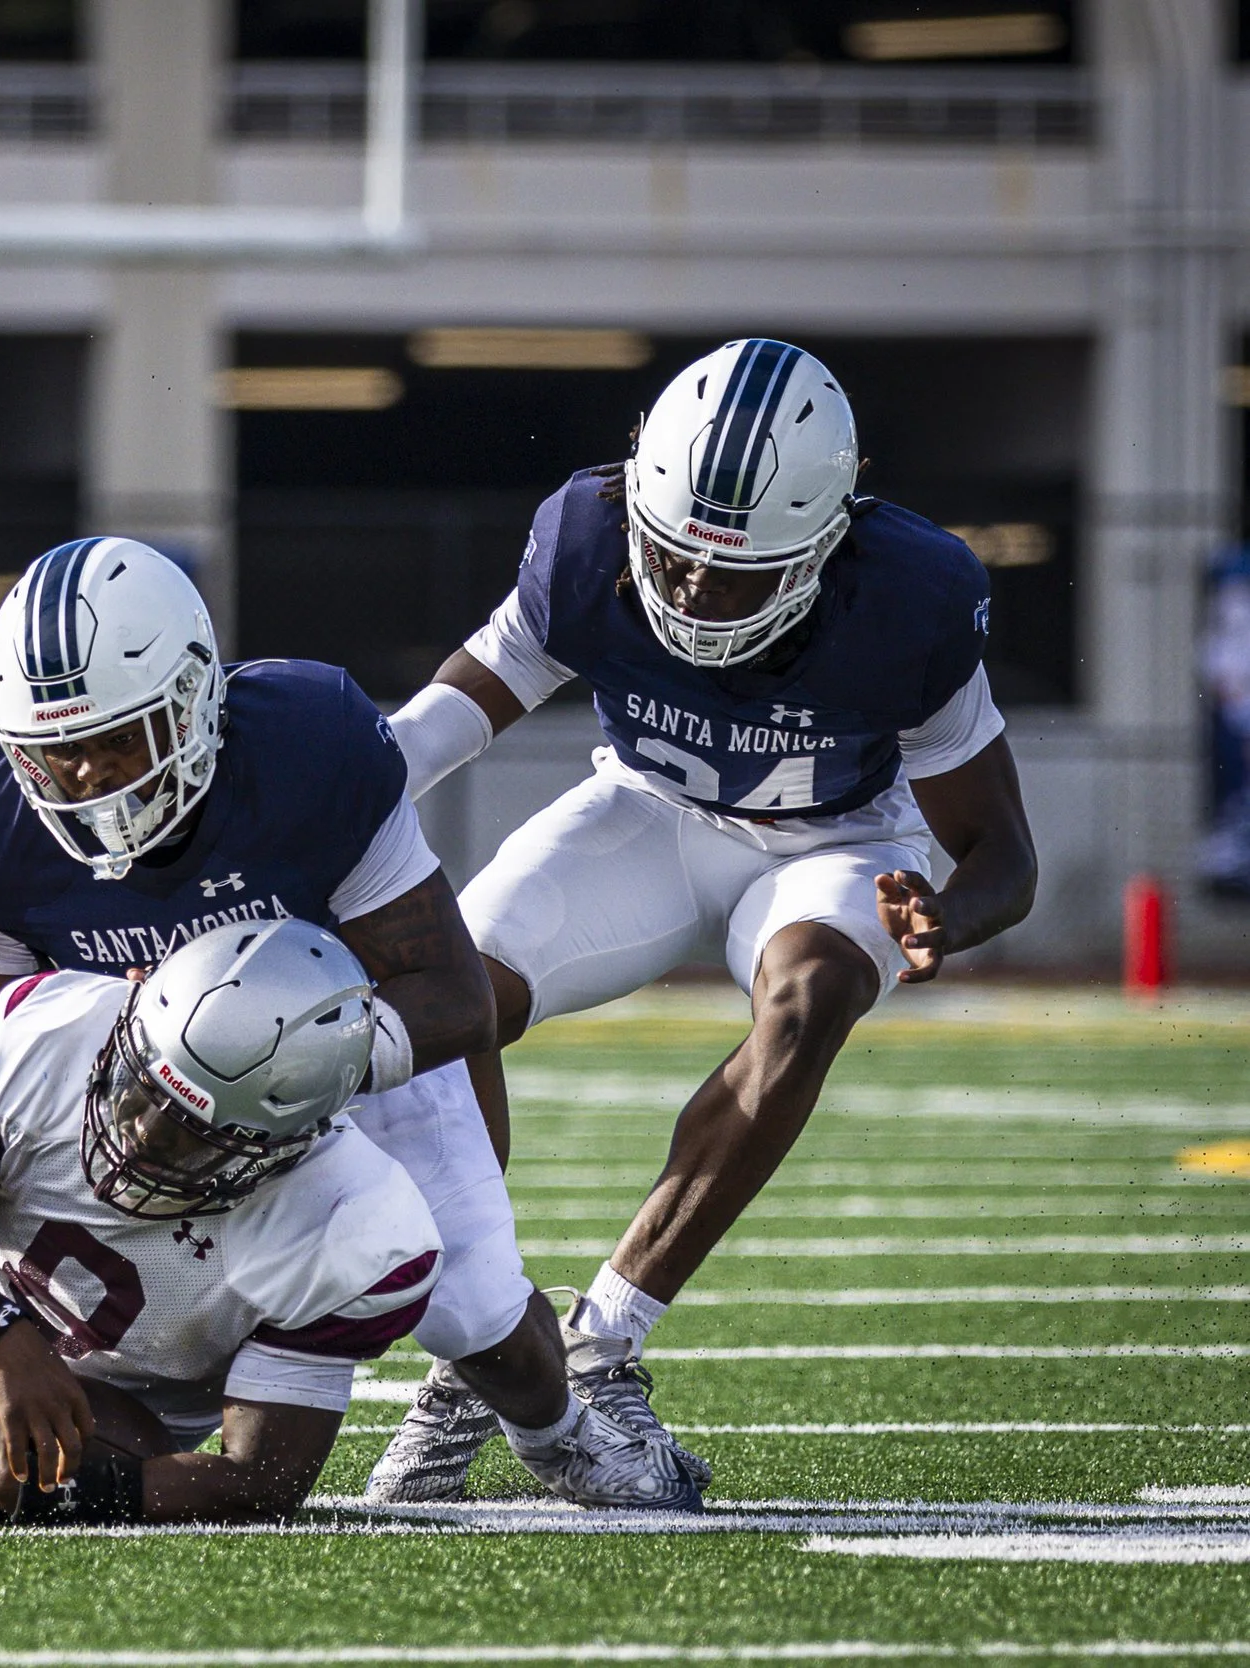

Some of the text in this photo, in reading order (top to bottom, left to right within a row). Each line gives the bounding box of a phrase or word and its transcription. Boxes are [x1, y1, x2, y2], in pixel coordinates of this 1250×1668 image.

[687, 523, 744, 547] Riddell
[36, 704, 90, 721] Riddell
[626, 693, 837, 753] SANTA MONICA
[13, 748, 51, 788] Riddell
[71, 925, 172, 963] SANTA
[159, 1064, 210, 1111] Riddell
